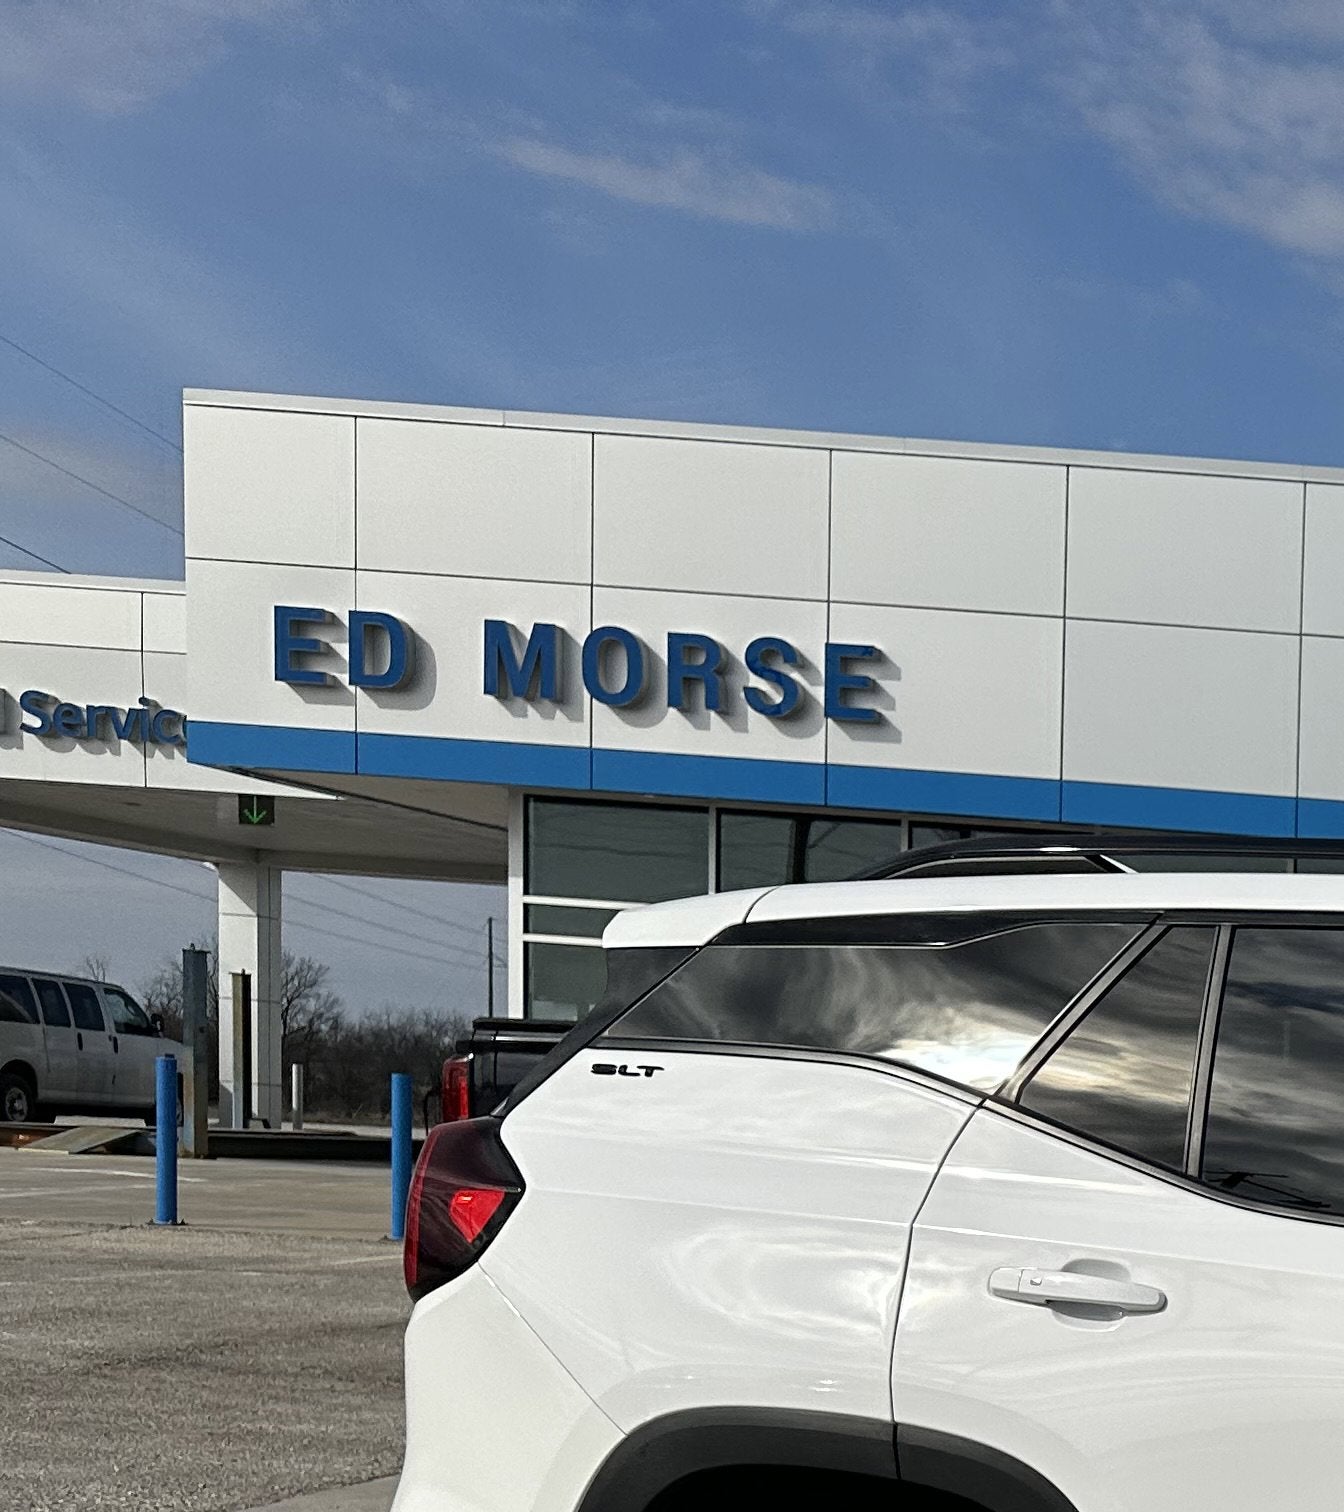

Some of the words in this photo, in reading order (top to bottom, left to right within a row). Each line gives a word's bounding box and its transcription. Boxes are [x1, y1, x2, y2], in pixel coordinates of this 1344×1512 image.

[273, 605, 416, 690] ED
[483, 618, 884, 725] MORSE
[20, 689, 188, 746] Servic
[590, 1063, 665, 1078] SLT
